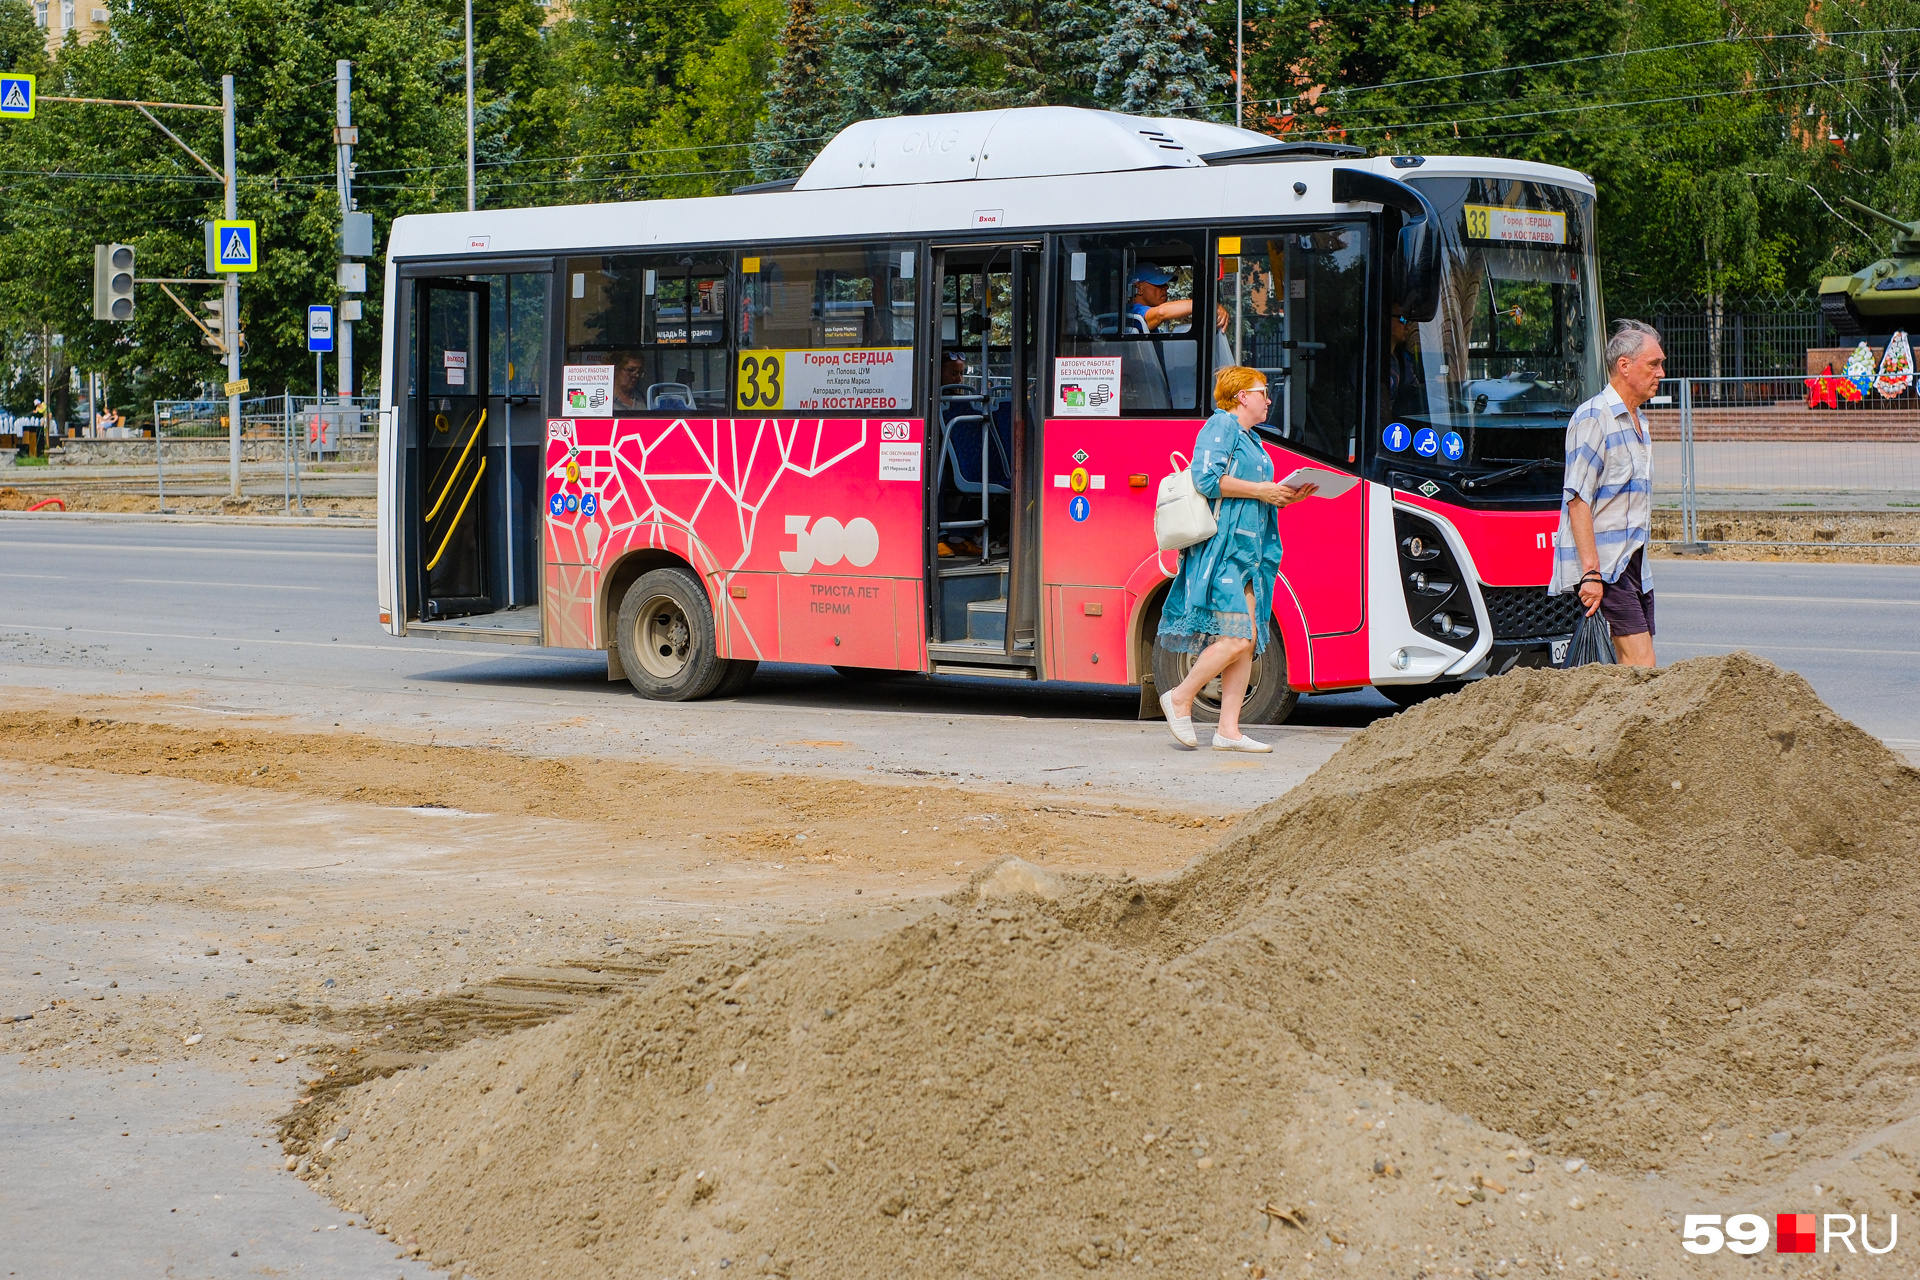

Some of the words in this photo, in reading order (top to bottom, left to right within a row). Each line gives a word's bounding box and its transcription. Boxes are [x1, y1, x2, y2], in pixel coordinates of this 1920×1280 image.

[903, 130, 959, 153] CNG
[1469, 210, 1487, 239] 33
[1503, 215, 1523, 227] Город
[1525, 217, 1552, 228] СЕРДЦА
[1514, 231, 1554, 242] КОСТАРЕВО
[804, 353, 839, 366] Город
[843, 352, 894, 365] СЕРДЦА
[836, 368, 857, 376] Попова,
[858, 368, 870, 376] ЦУМ
[740, 356, 780, 407] 33
[813, 387, 842, 395] Авторадио,
[852, 387, 884, 395] Пушкарская
[800, 398, 818, 410] м/р
[822, 397, 896, 409] КОСТАРЕВО
[779, 515, 879, 577] 300
[810, 584, 855, 597] ТРИСТА
[857, 586, 880, 598] ЛЕТ
[810, 602, 851, 615] ПЕРМИ
